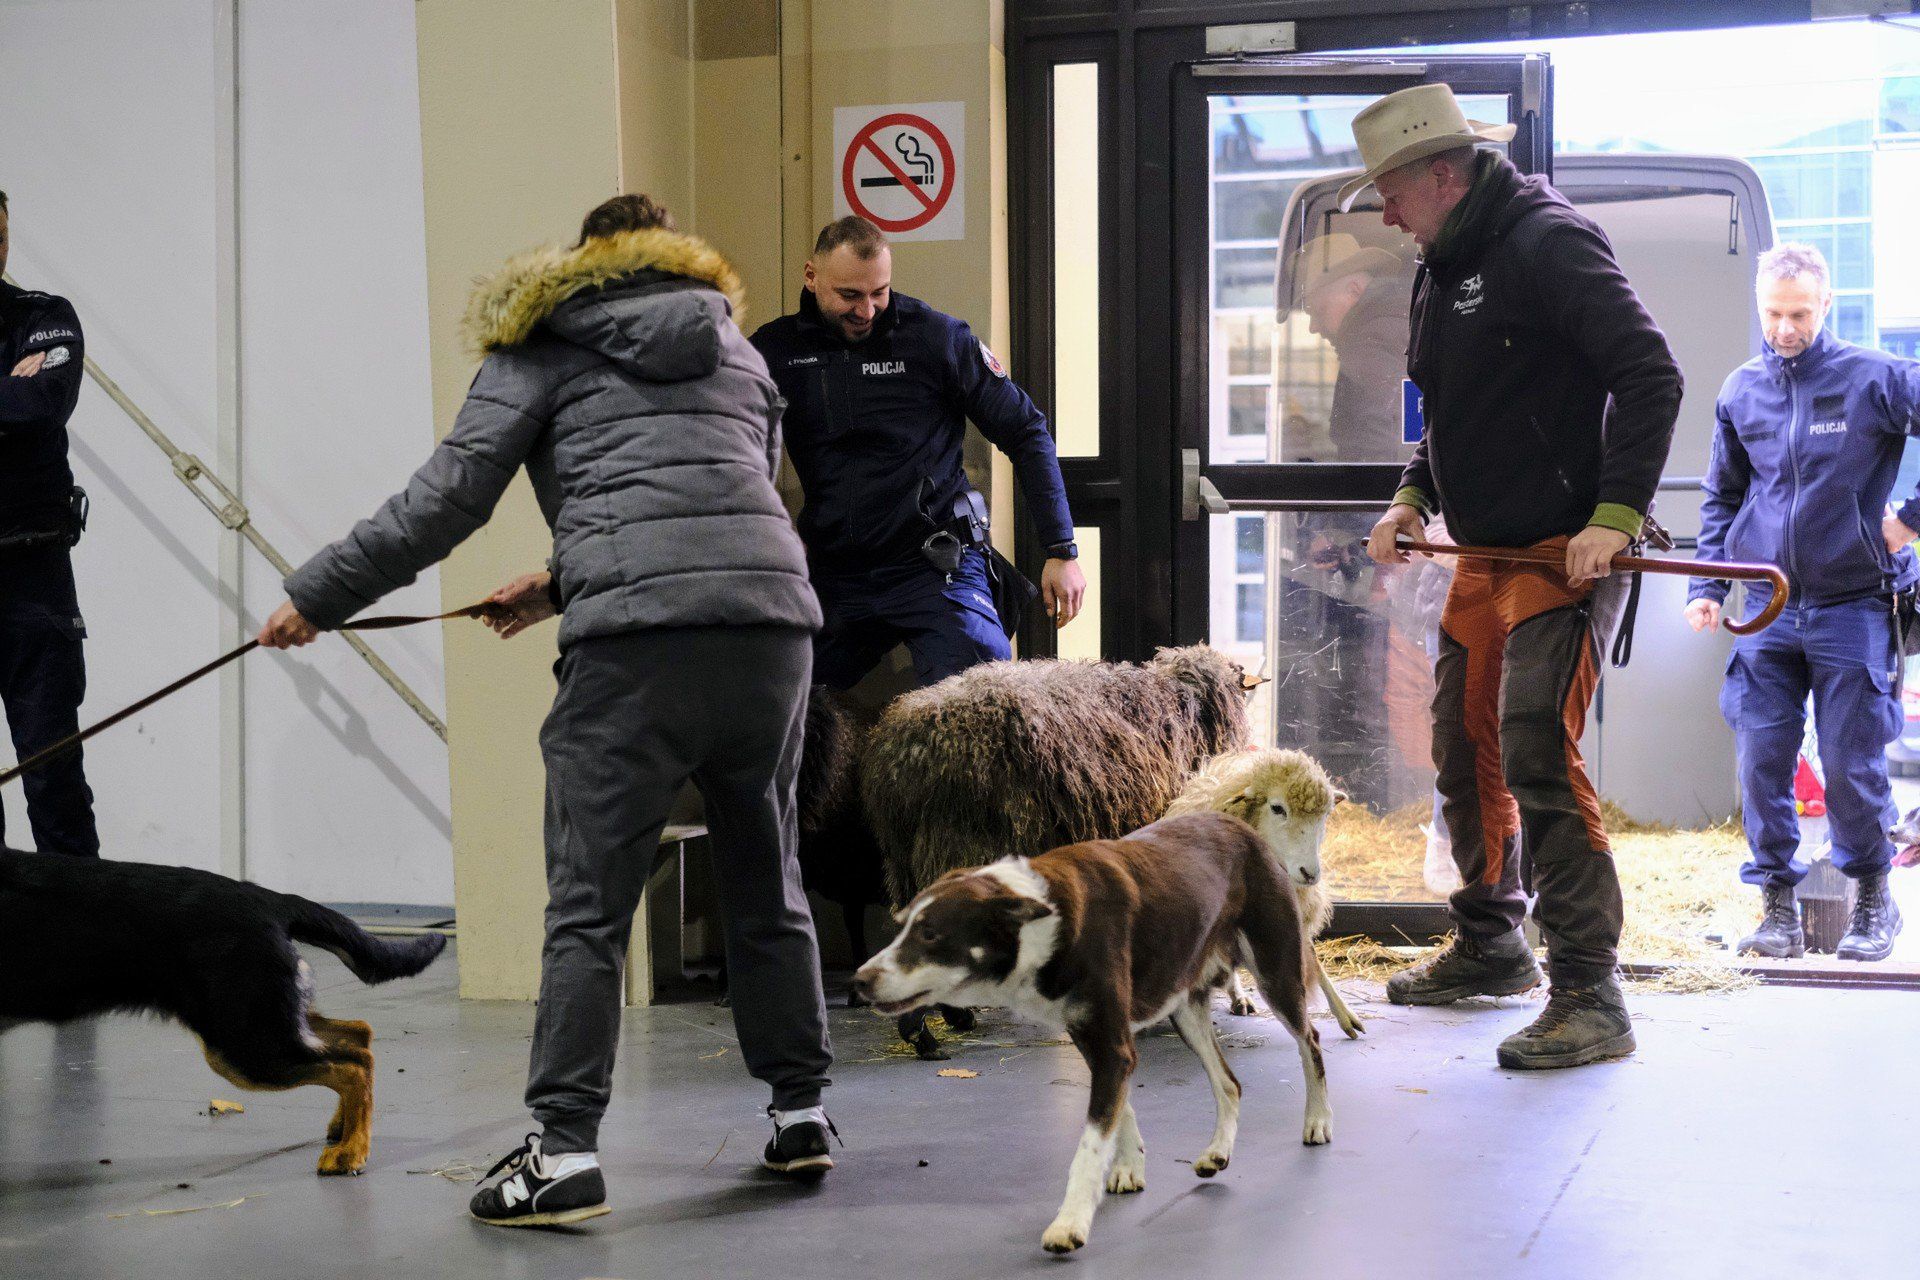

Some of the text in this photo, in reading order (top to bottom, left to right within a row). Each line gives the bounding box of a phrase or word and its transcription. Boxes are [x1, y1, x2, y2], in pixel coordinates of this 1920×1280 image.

[29, 329, 74, 344] POLICJA
[861, 361, 906, 375] POLICJA
[1809, 421, 1847, 435] POLICJA
[501, 1173, 530, 1208] N
